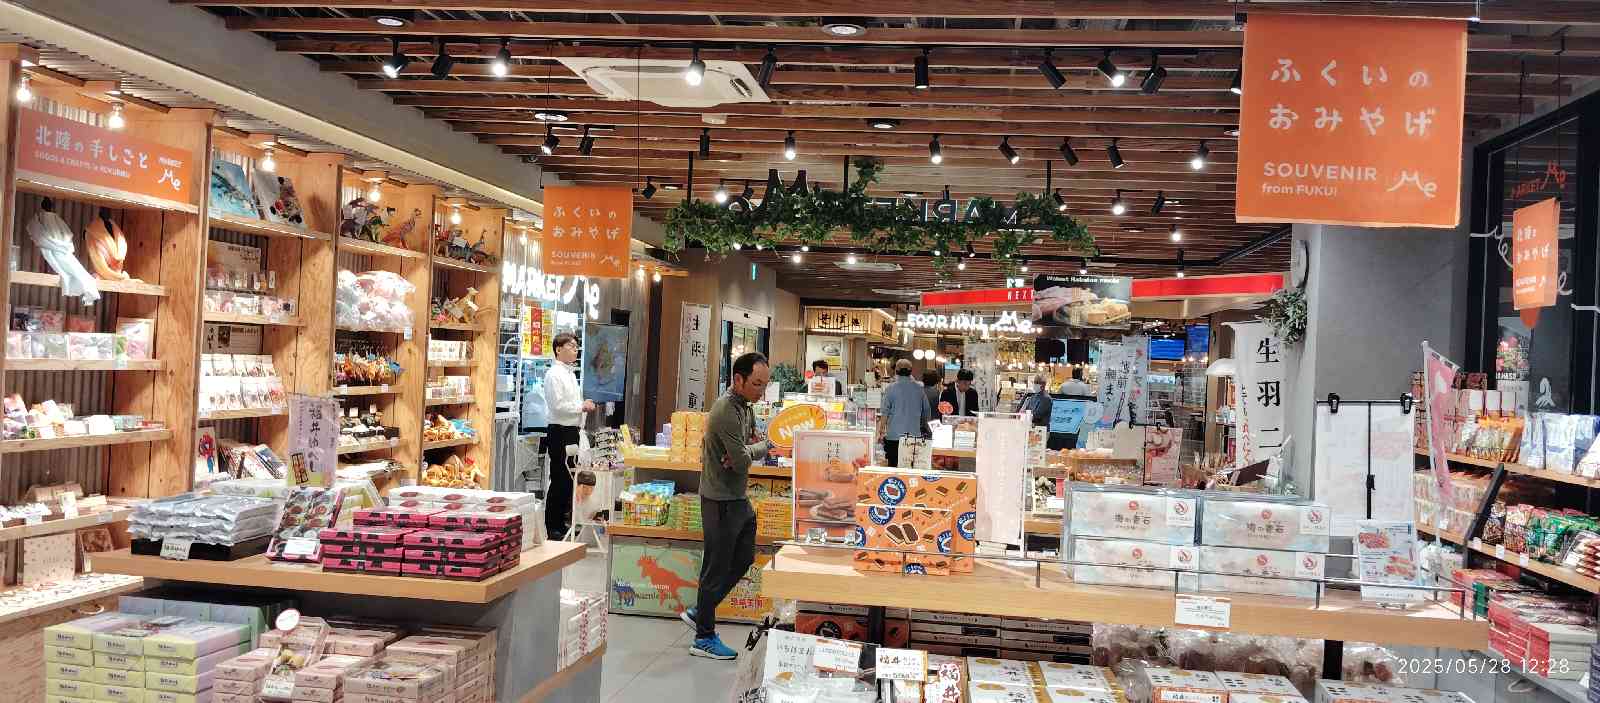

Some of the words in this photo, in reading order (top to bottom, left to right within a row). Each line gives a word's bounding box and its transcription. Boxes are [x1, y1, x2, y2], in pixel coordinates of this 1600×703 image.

[1270, 58, 1429, 87] ふくいの
[1269, 103, 1437, 137] おみやげ
[35, 127, 149, 169] 北陸の手しごと
[1263, 161, 1377, 181] SOUVENIR
[1262, 183, 1294, 195] from
[1297, 184, 1337, 197] FUKUI
[553, 206, 617, 220] ふくいの
[552, 226, 623, 241] おみやげ
[551, 251, 597, 260] SOUVENIR
[907, 313, 948, 327] FOOD
[951, 314, 984, 331] HALL
[1256, 337, 1283, 449] 生羽二
